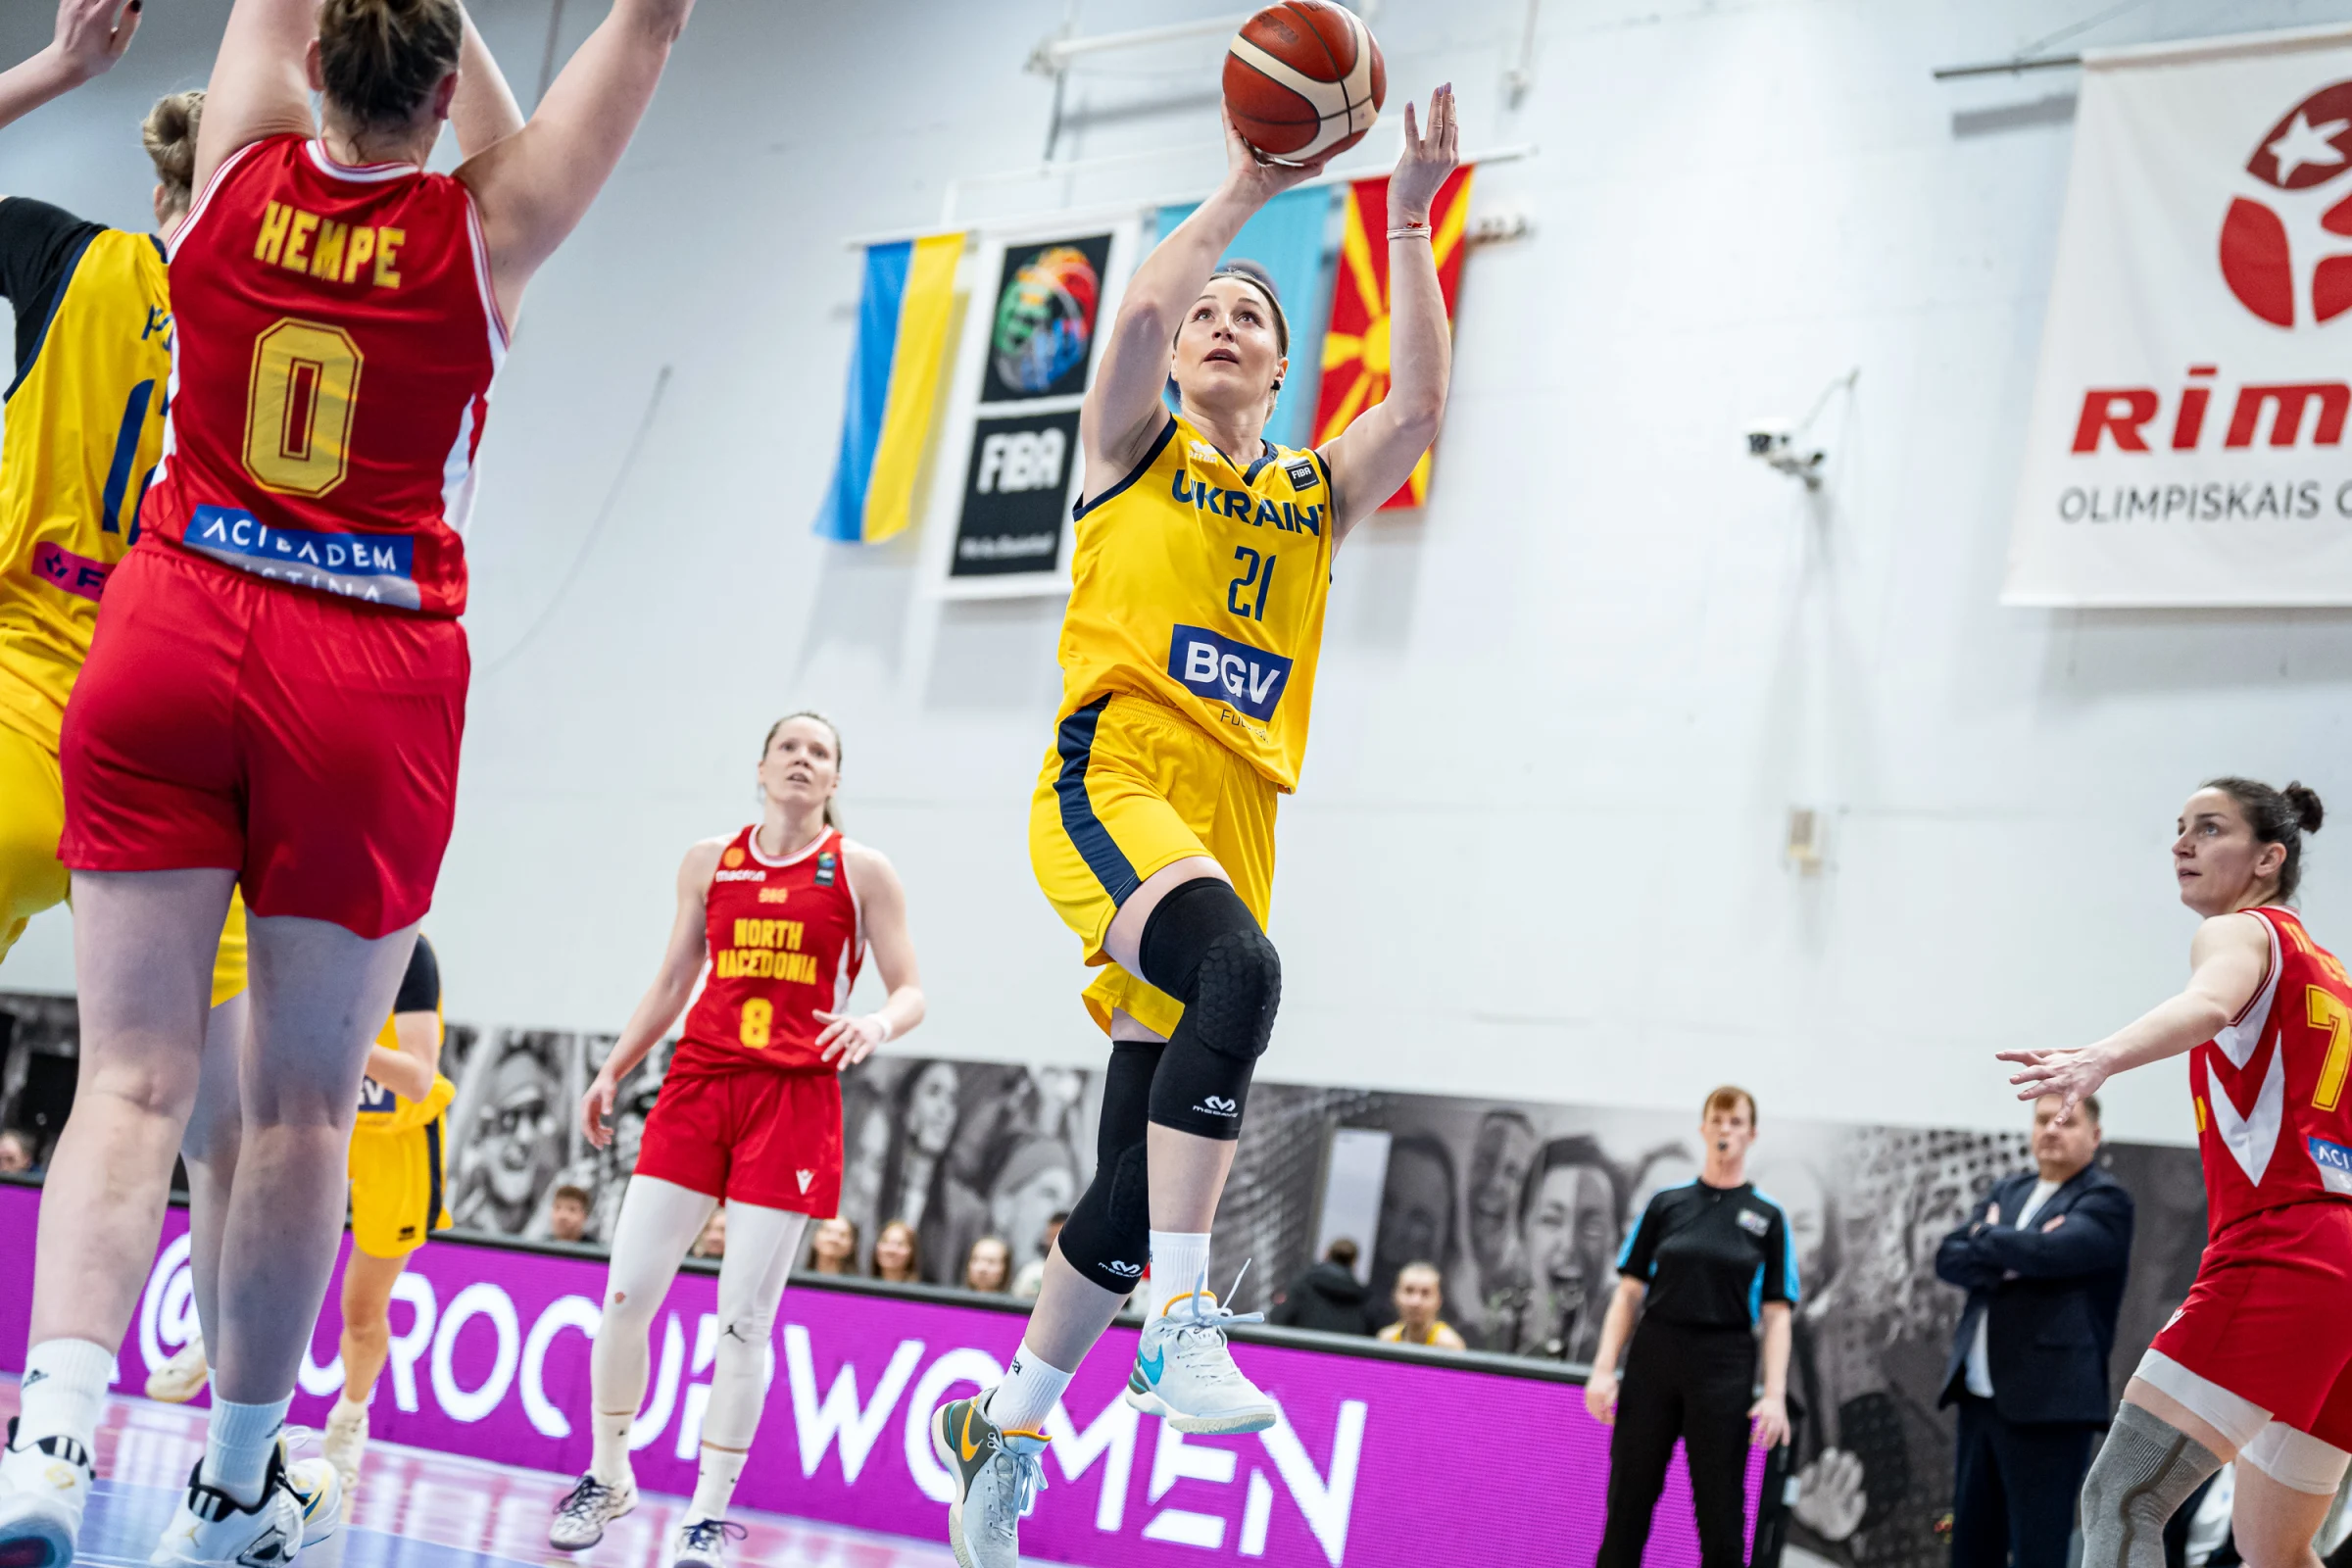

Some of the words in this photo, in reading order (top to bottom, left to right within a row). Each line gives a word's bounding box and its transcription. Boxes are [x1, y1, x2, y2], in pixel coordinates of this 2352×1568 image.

[254, 199, 406, 290] HEMPE
[242, 316, 366, 500] 0
[101, 378, 169, 546] 1
[976, 426, 1067, 495] FIBA
[1292, 466, 1312, 480] FIBA
[2058, 480, 2322, 525] OLIMPISKAIS
[77, 566, 105, 595] F
[1227, 545, 1277, 622] 21
[1184, 640, 1281, 705] BGV
[733, 917, 805, 952] NORTH
[739, 997, 773, 1051] 8
[2319, 1145, 2352, 1170] ACI
